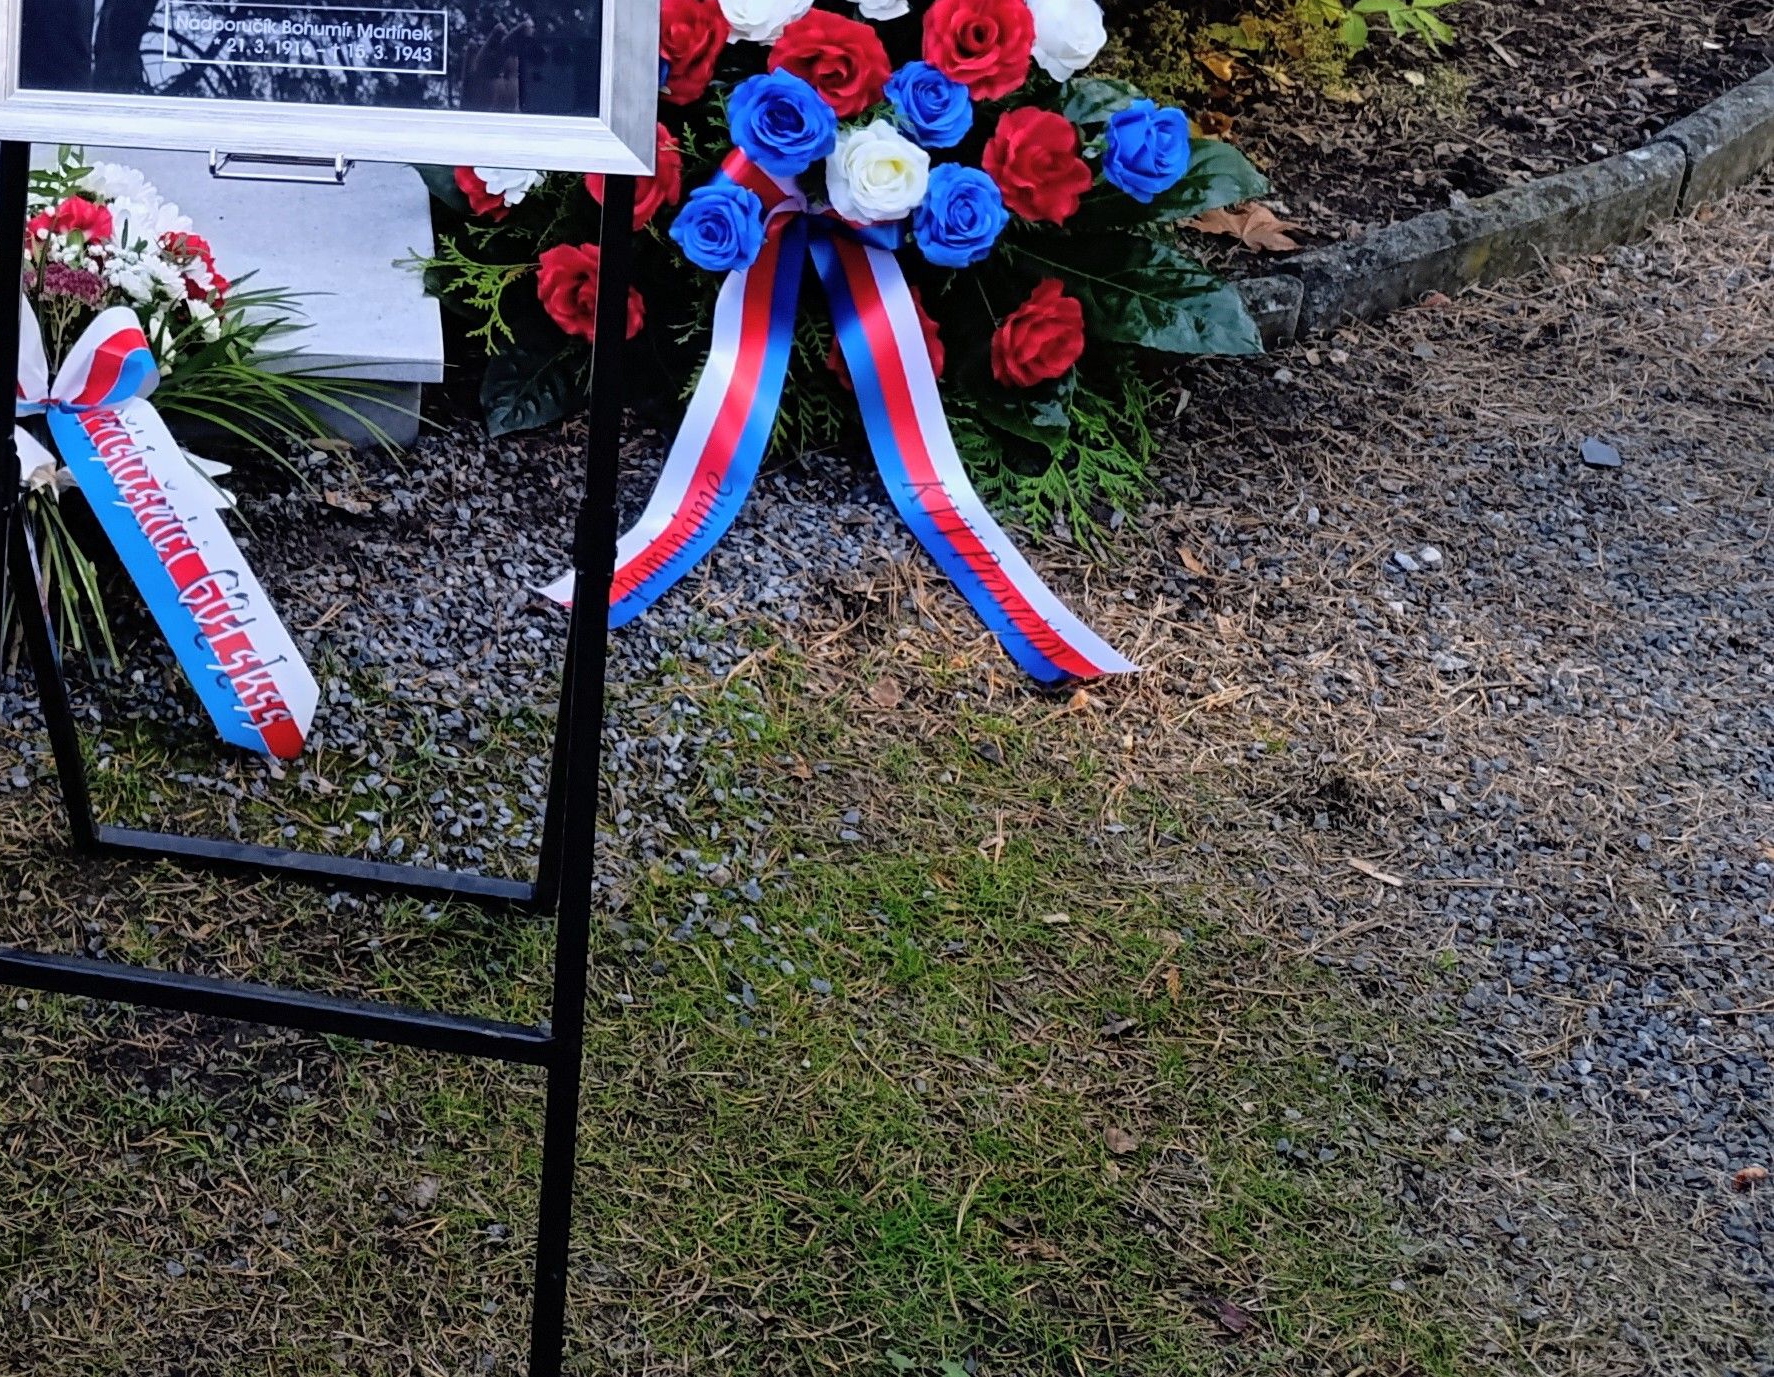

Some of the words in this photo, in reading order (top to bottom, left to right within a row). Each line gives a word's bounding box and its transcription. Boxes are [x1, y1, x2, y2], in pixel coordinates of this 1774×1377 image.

[176, 14, 278, 39] Nadporučík
[280, 19, 355, 38] Bohumír
[356, 22, 434, 43] Martínek
[226, 38, 251, 54] 21.
[254, 39, 271, 55] 3.
[274, 39, 312, 57] 1916
[346, 43, 369, 60] 15.
[373, 44, 389, 61] 3.
[394, 45, 433, 64] 1943
